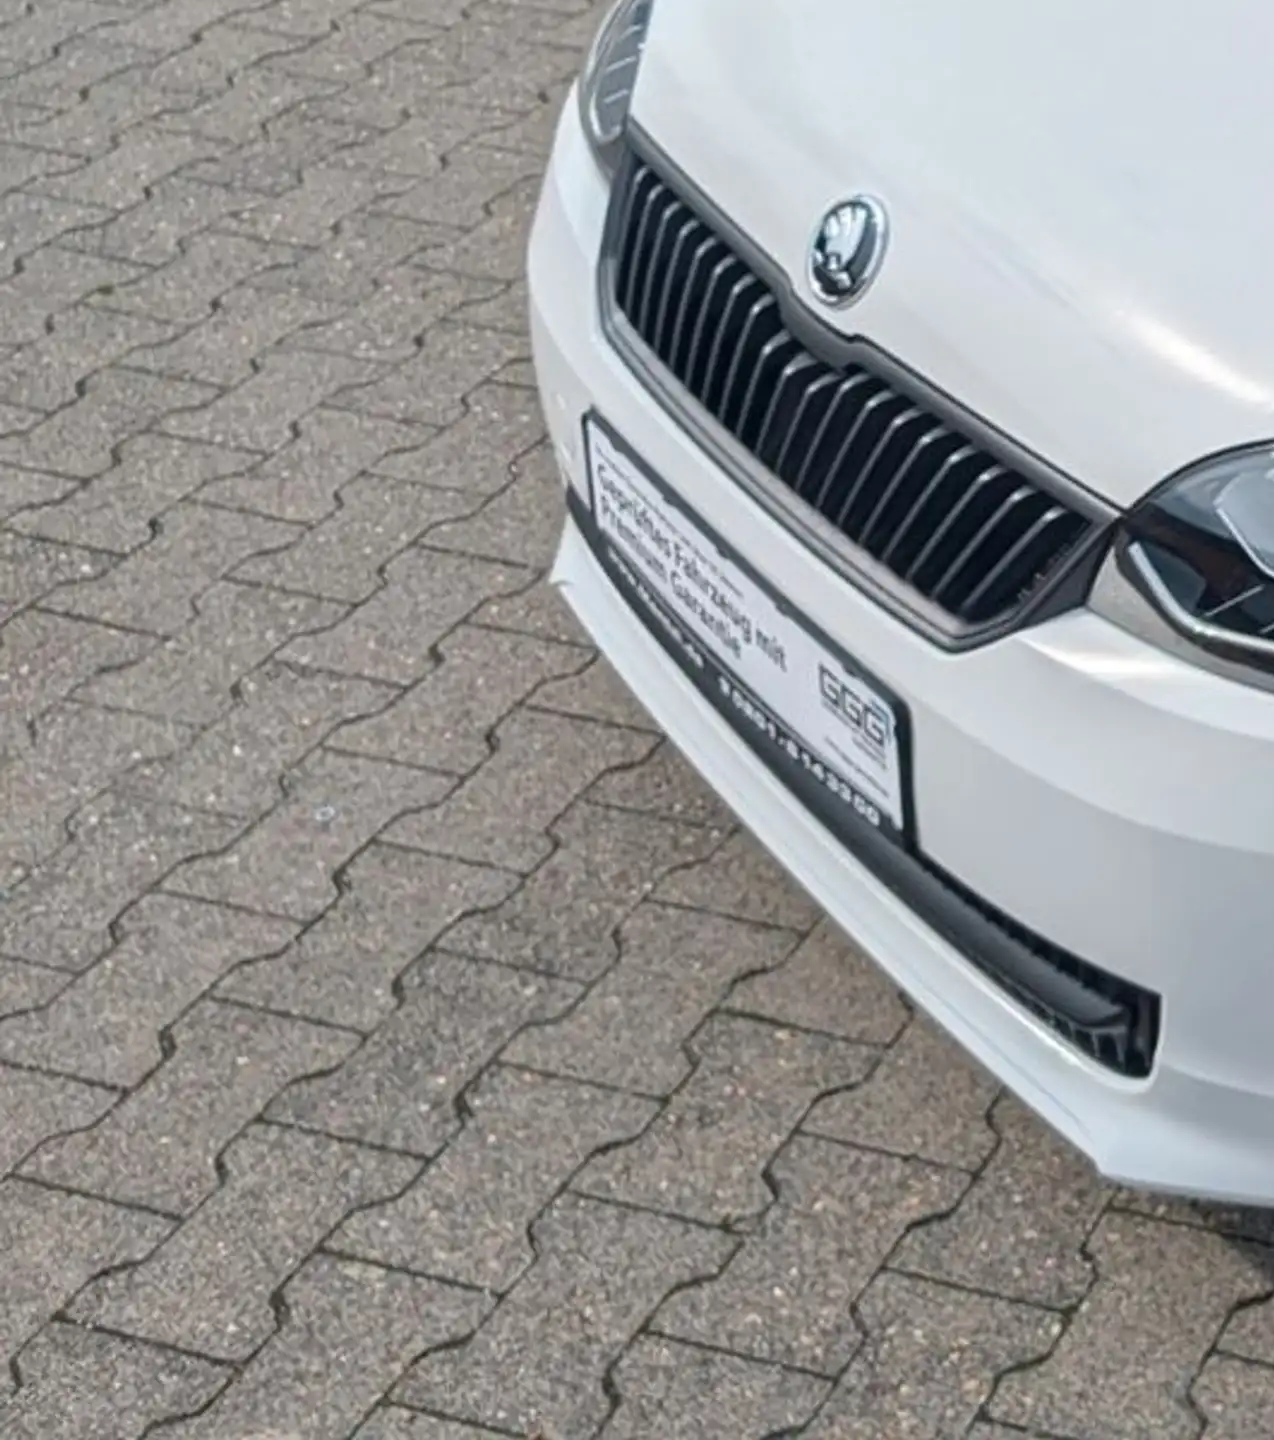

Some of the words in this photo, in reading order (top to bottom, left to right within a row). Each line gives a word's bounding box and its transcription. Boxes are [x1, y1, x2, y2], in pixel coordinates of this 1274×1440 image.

[673, 541, 753, 645] Fahrzeug
[755, 626, 788, 673] mit
[818, 662, 887, 748] GGG
